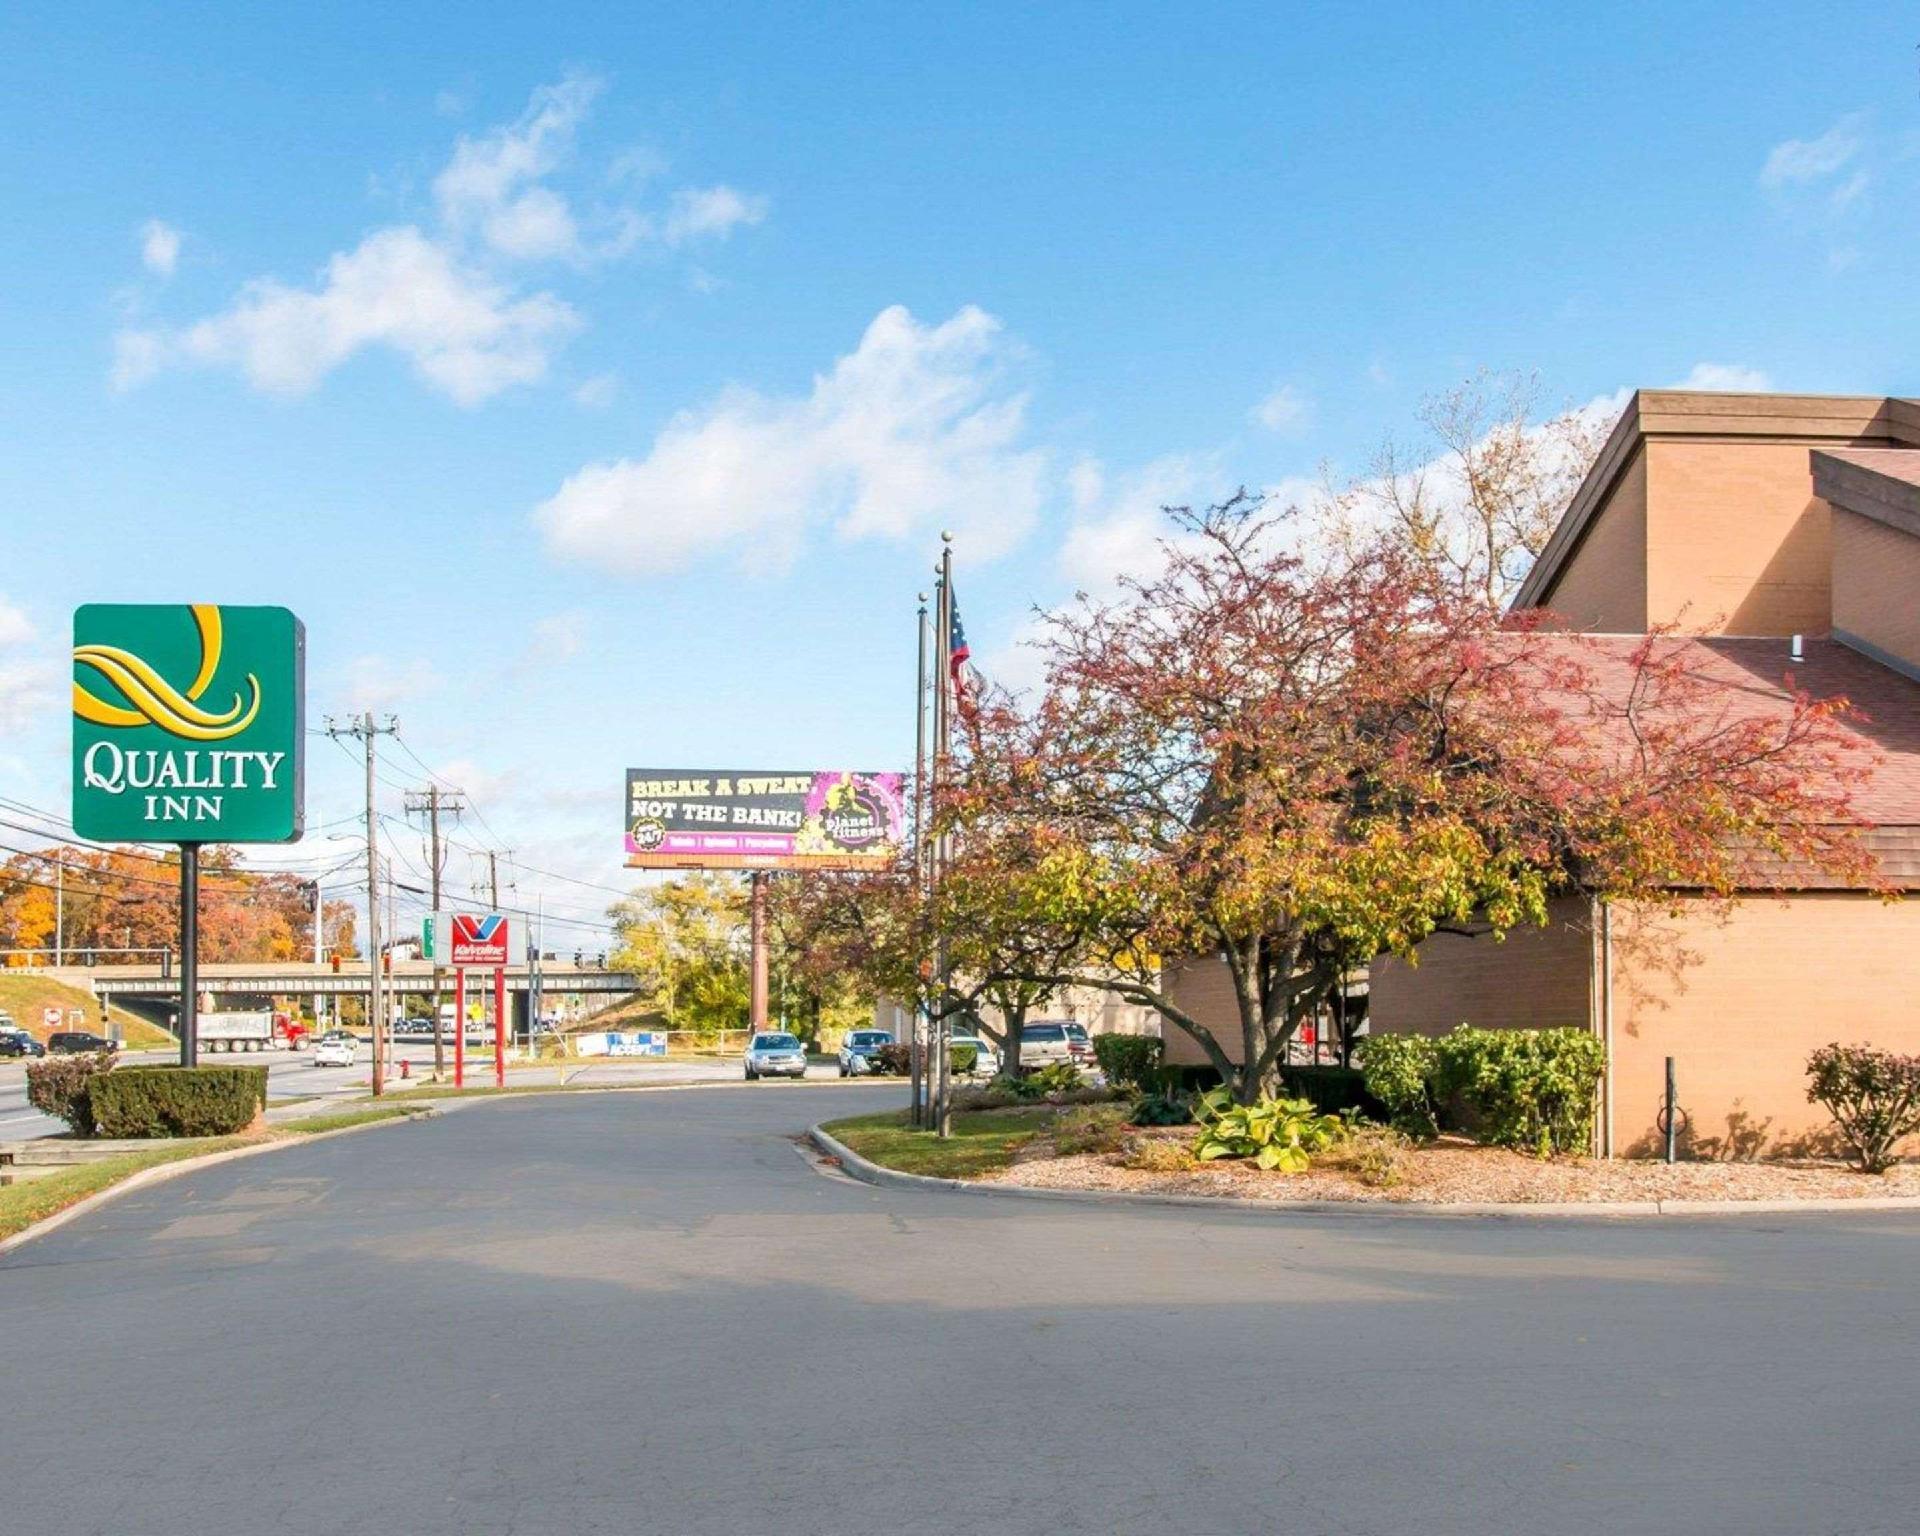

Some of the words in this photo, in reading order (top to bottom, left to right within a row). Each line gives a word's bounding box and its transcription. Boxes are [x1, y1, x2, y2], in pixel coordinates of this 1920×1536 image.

[84, 741, 285, 793] QUALITY
[632, 780, 711, 798] BREAK
[715, 778, 733, 796] A
[737, 776, 811, 795] SWEAT
[144, 796, 223, 821] INN
[631, 800, 677, 818] NOT
[682, 803, 727, 822] THE
[732, 807, 801, 827] BANK!
